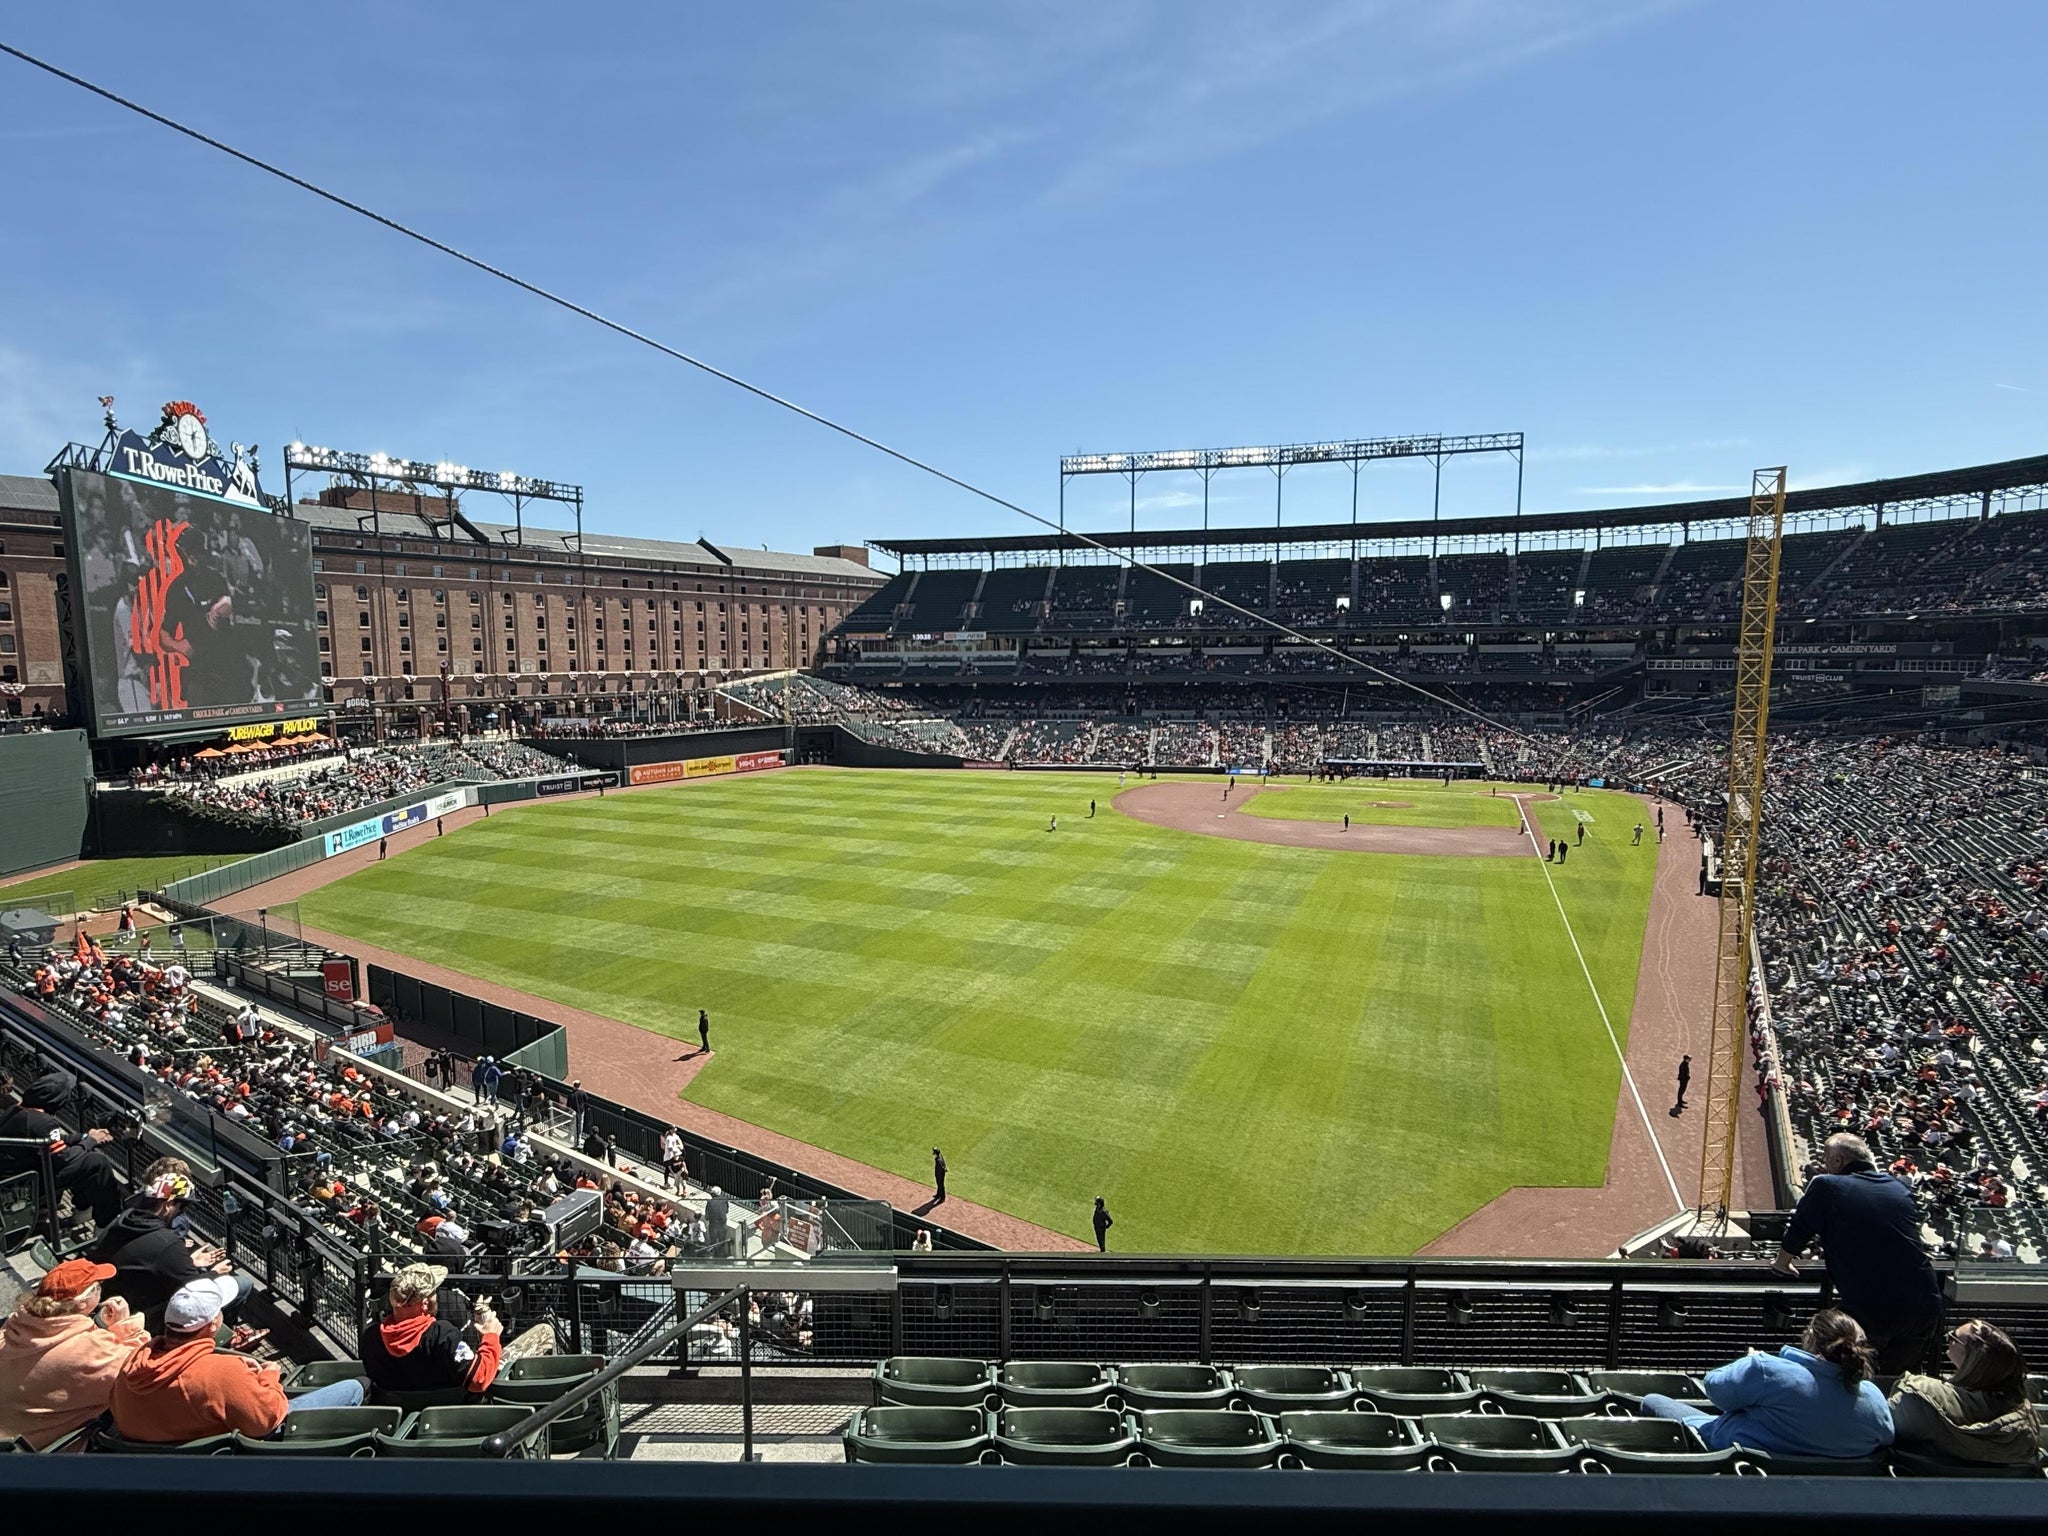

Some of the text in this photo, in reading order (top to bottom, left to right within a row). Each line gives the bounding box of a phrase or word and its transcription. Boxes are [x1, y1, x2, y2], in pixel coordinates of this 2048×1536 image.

[1772, 646, 1797, 654] RIOLE
[1798, 646, 1820, 654] PARK
[1830, 645, 1868, 654] CAMDEN
[1868, 645, 1897, 653] YARDS
[282, 718, 317, 734] PAVILION
[643, 768, 666, 776] AUTUMN
[667, 765, 681, 773] LAKE
[349, 1030, 377, 1050] BIRD
